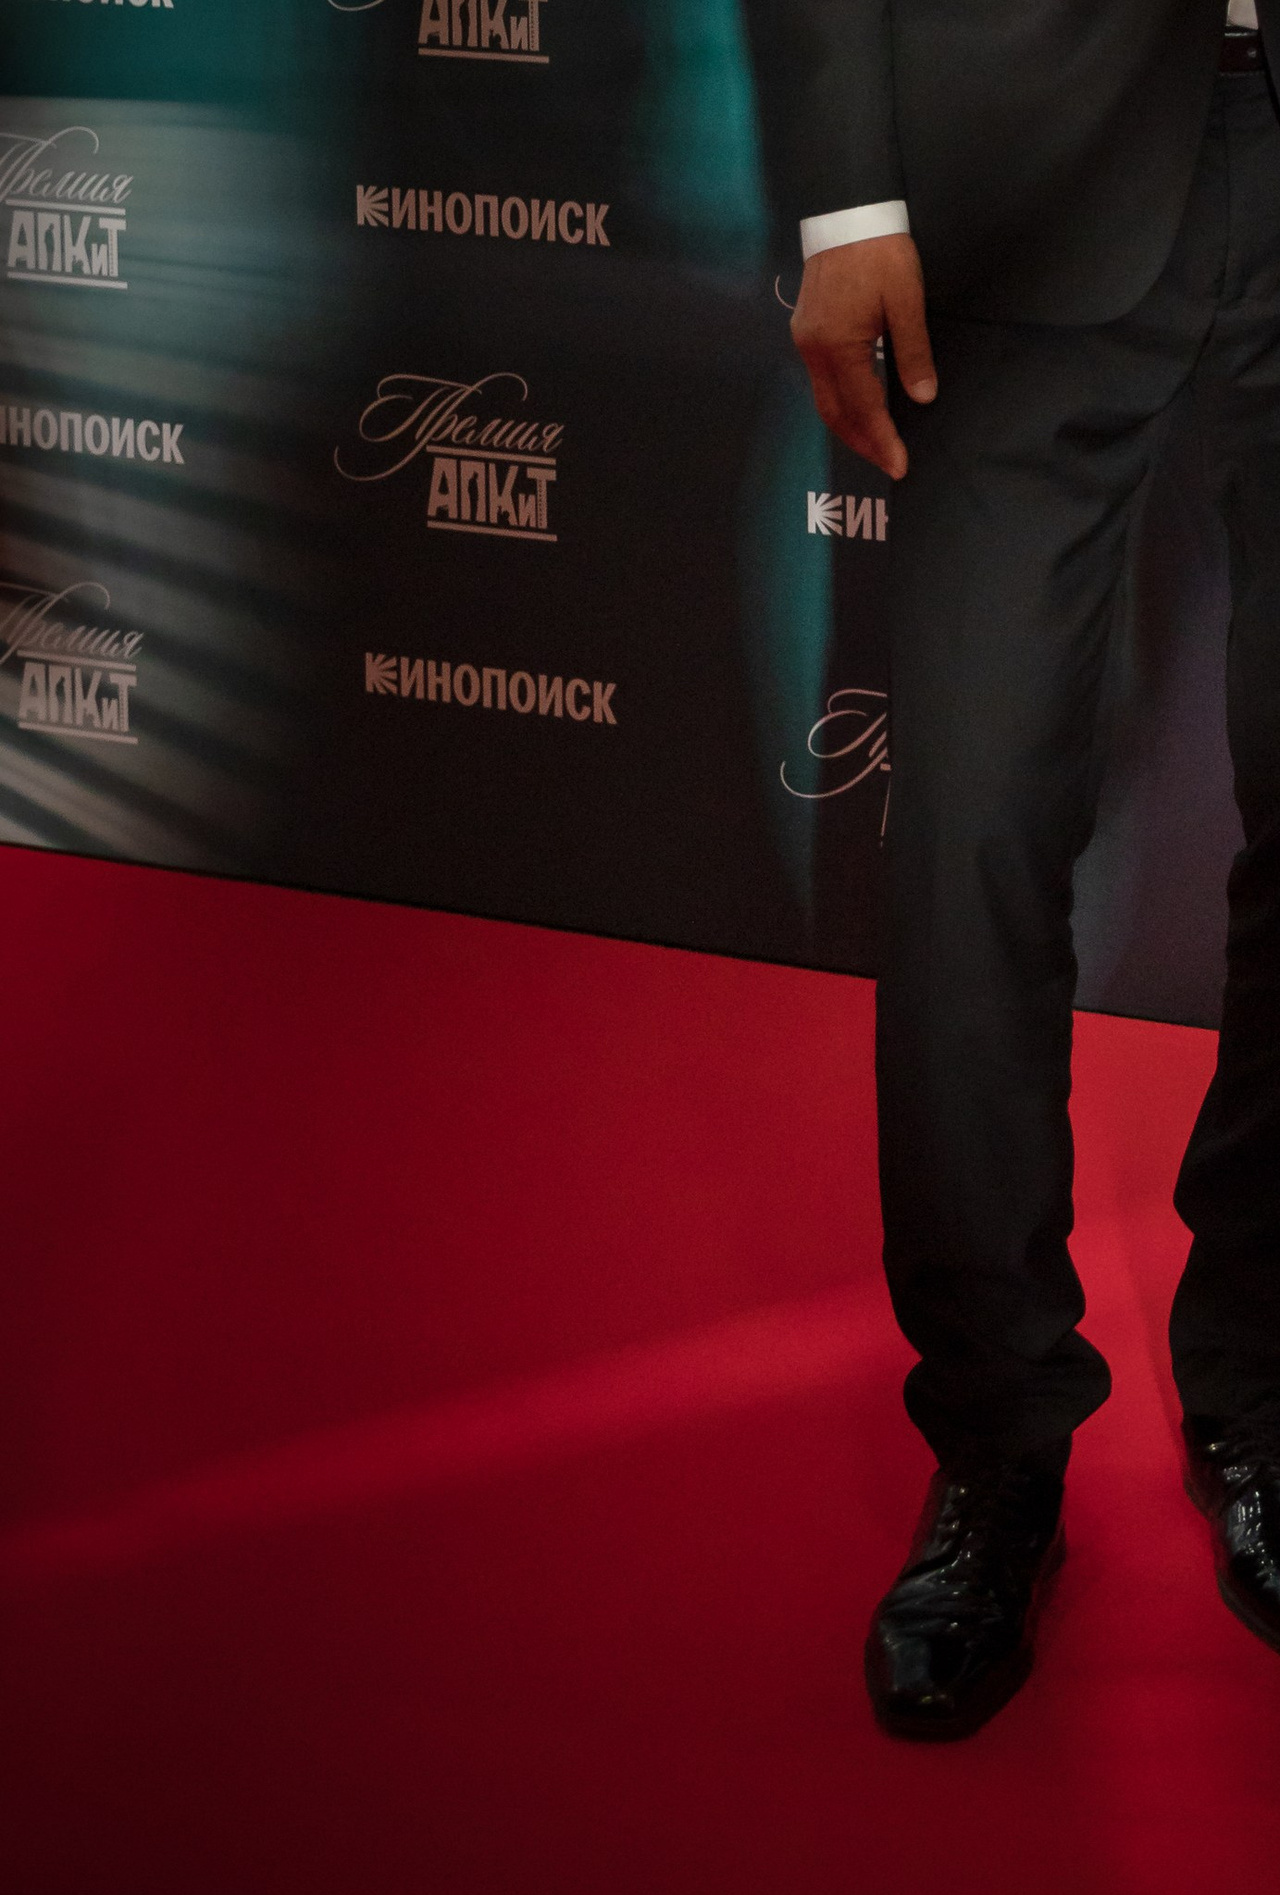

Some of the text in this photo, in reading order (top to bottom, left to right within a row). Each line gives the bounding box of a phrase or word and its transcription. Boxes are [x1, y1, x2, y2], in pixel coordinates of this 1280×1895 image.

[355, 184, 612, 247] КИНОПОИСК
[0, 405, 187, 467] НОПОИСК
[334, 372, 566, 482] Премия
[364, 651, 619, 726] КИНОПОИСК
